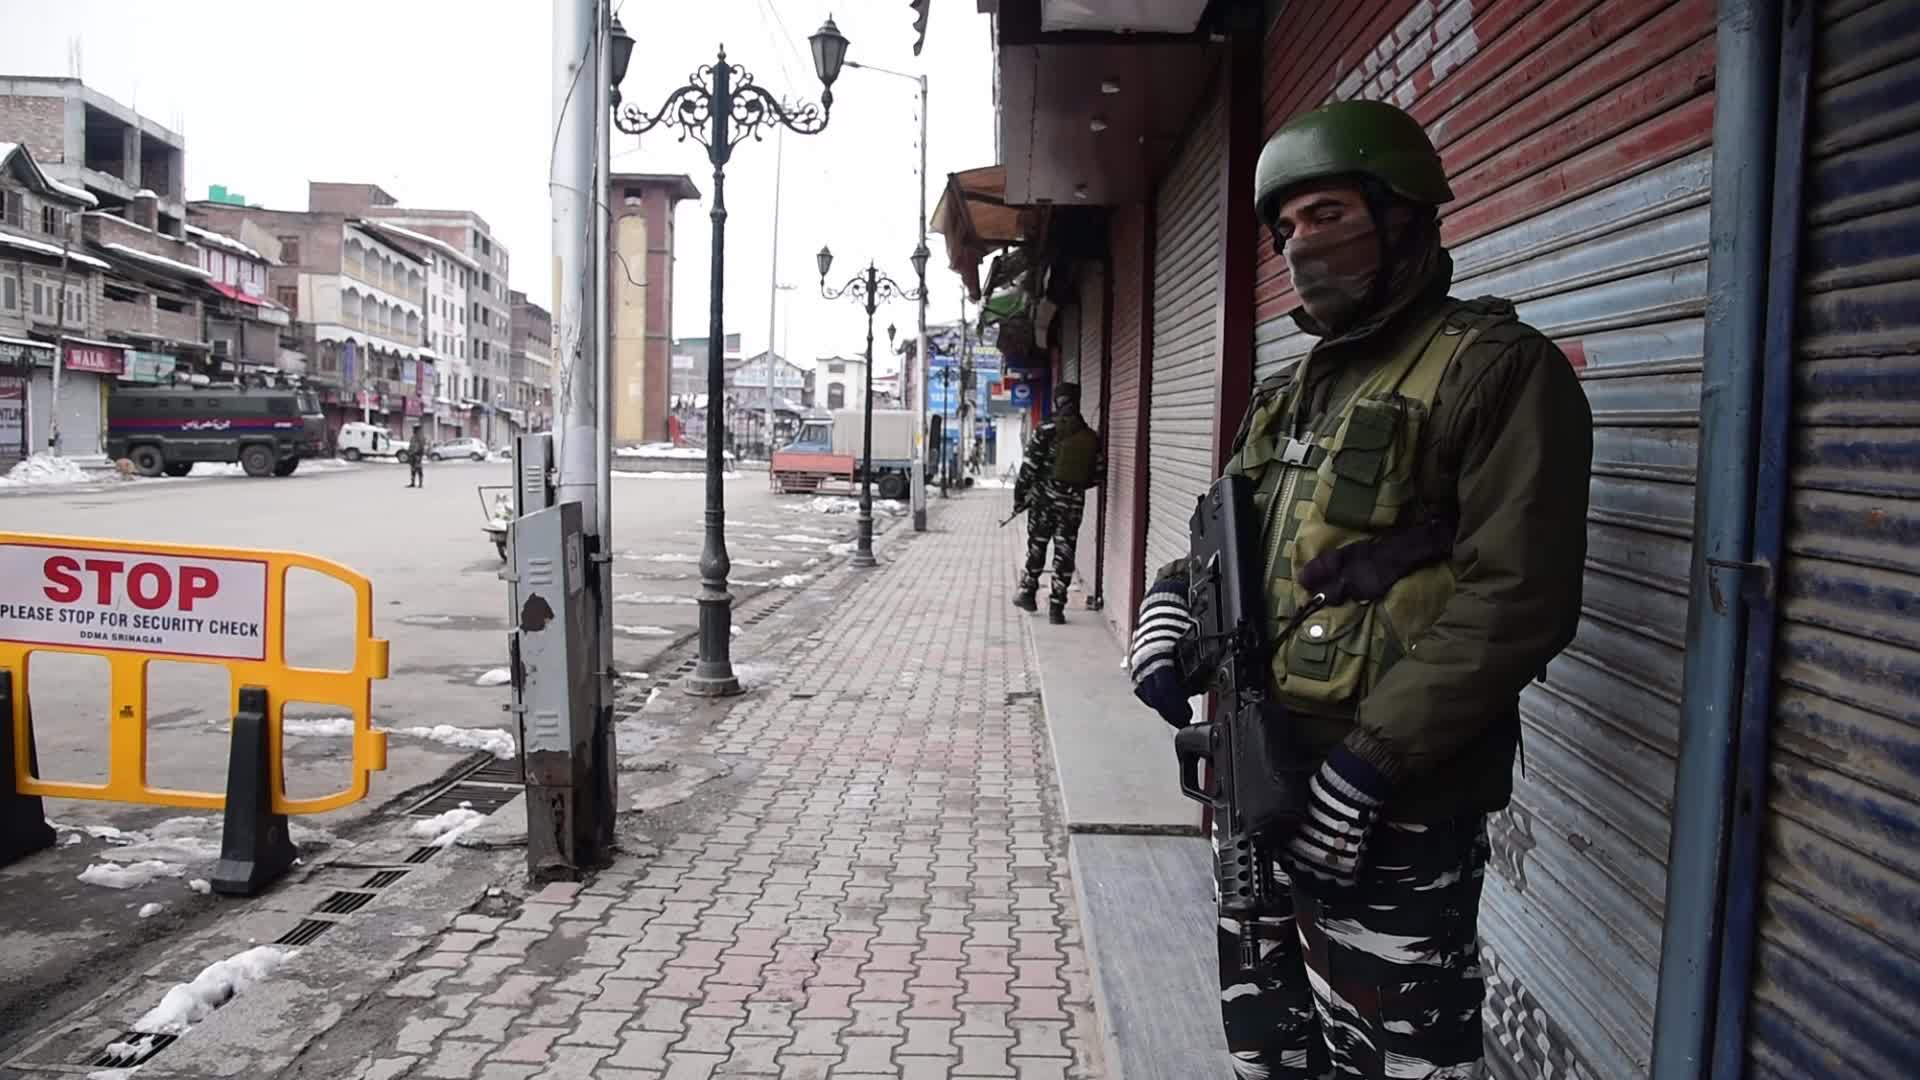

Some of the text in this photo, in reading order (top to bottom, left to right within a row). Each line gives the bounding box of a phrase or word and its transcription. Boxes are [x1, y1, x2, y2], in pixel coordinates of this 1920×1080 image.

[70, 350, 104, 367] WALK
[43, 555, 219, 611] STOP
[0, 604, 259, 637] PLEASE STOP FOR SECURITY CHECK
[80, 631, 163, 644] DDMA SRINAGAR
